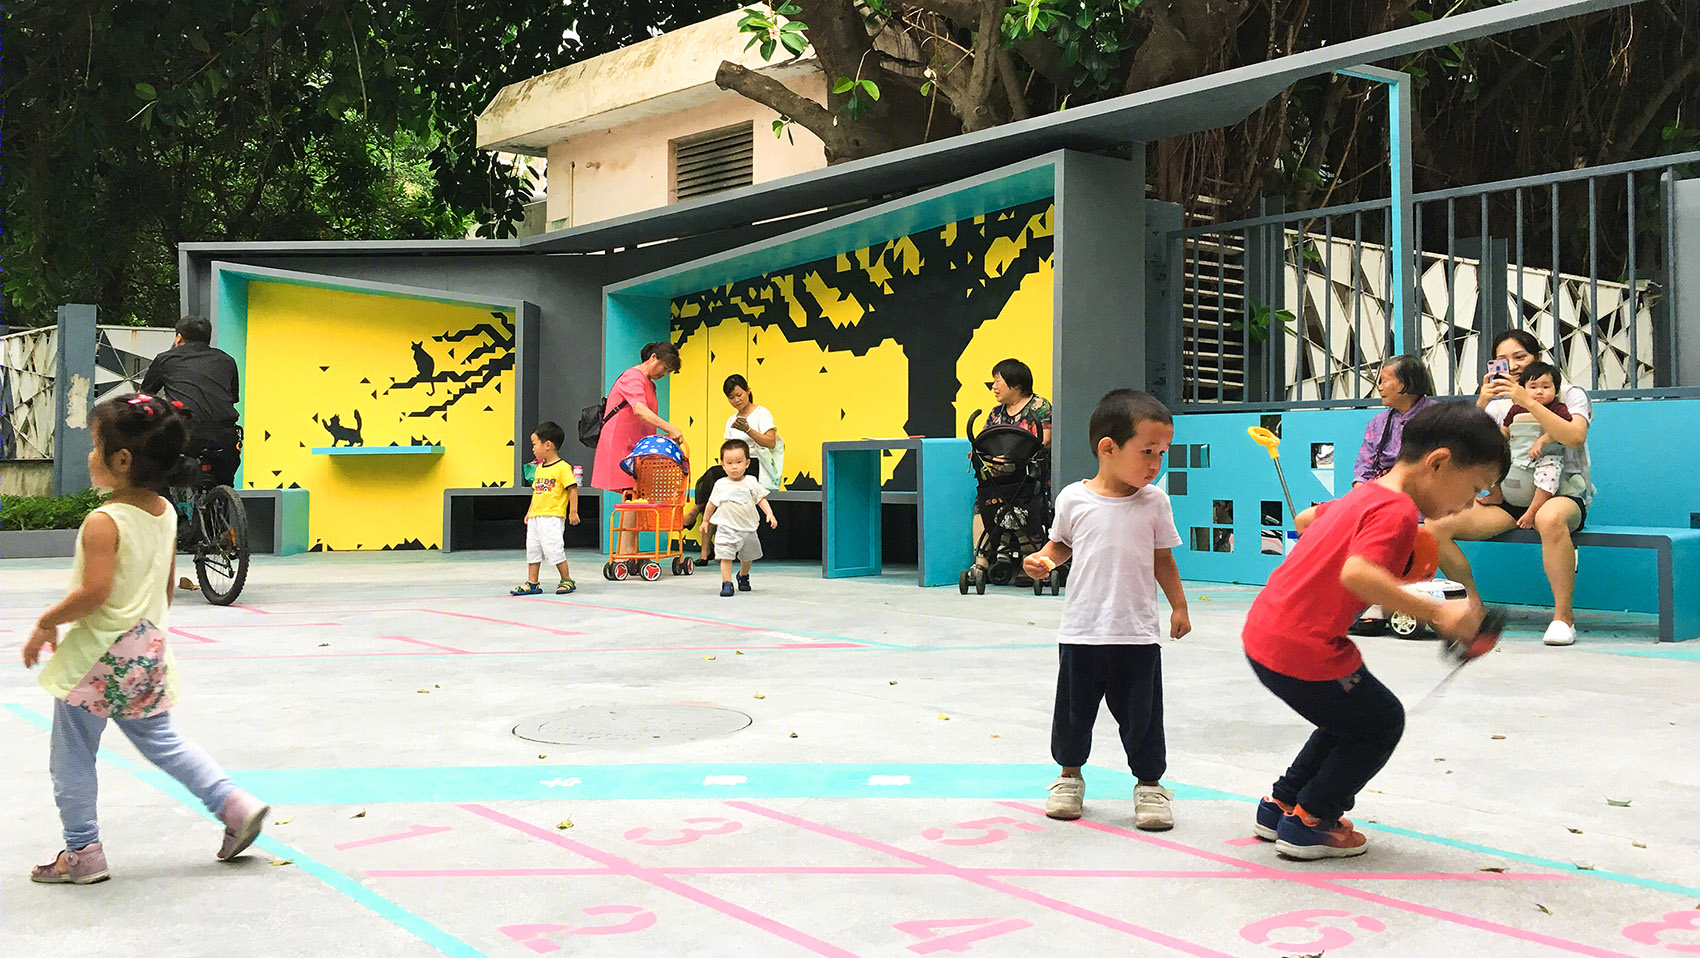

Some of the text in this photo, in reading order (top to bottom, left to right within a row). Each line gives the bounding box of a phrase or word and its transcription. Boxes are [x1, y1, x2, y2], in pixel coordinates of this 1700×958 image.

[333, 823, 454, 850] 1
[623, 816, 743, 847] 3
[920, 816, 1047, 847] 5
[495, 904, 658, 955] 2
[892, 916, 1036, 955] 4
[1238, 908, 1388, 953] 6
